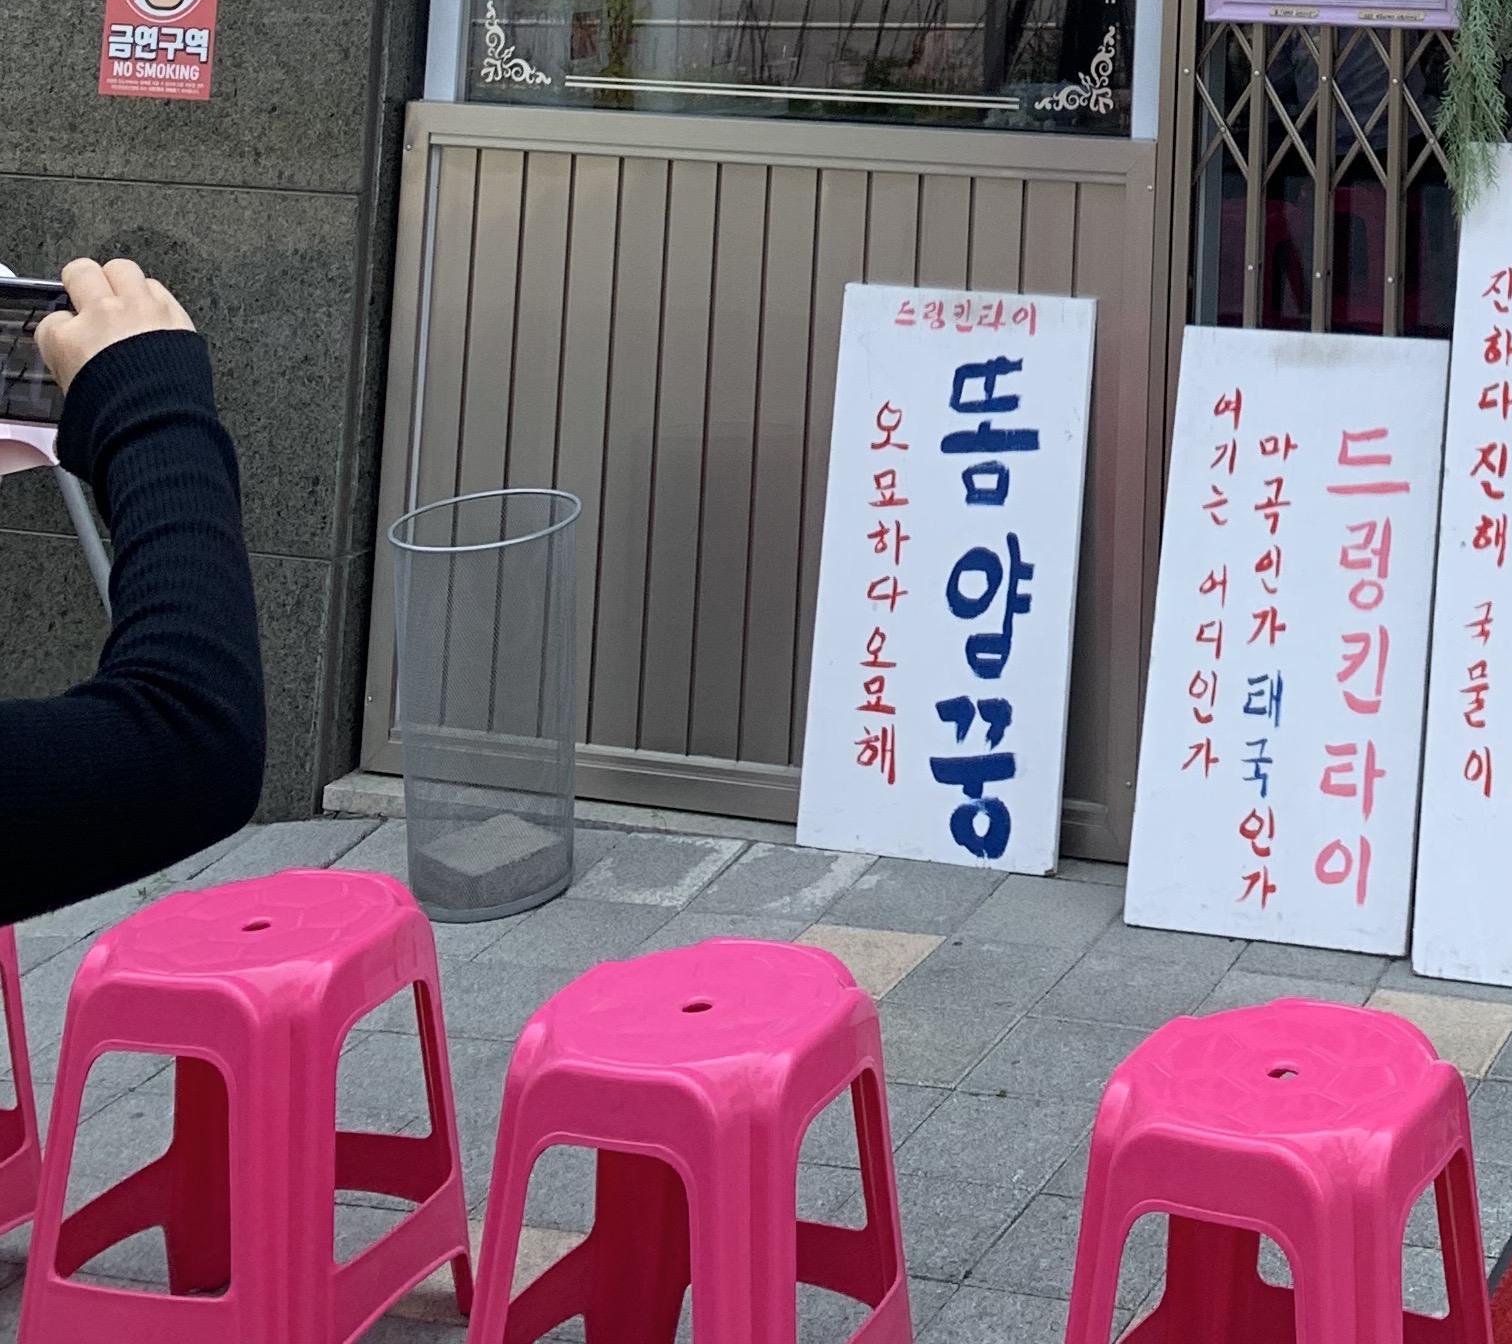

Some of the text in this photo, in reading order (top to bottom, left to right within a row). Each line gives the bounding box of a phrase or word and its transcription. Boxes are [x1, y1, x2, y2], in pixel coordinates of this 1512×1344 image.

[109, 23, 210, 63] 금연구역
[112, 61, 200, 81] NO SMOKING
